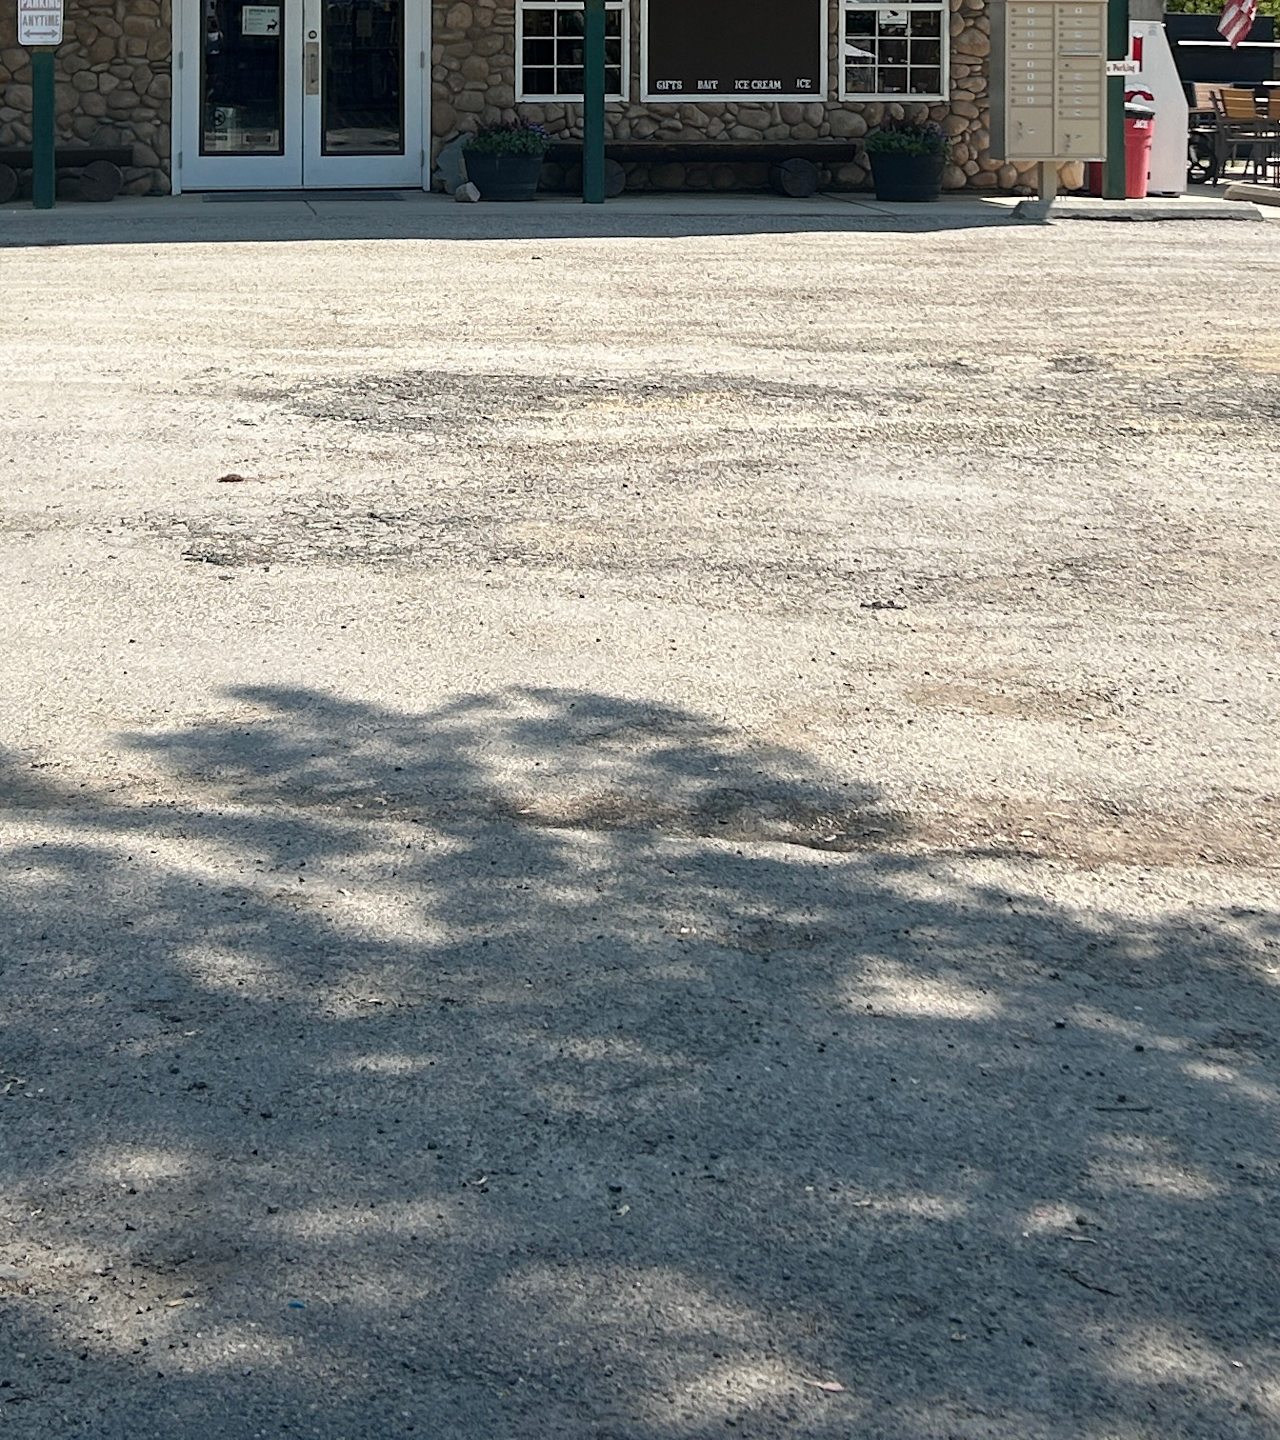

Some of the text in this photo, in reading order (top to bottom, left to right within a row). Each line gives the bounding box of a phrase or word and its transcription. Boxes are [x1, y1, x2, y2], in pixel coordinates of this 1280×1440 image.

[23, 15, 60, 26] ANYTIME
[656, 79, 811, 90] GIFTS BAIT ICE CREAM ICE
